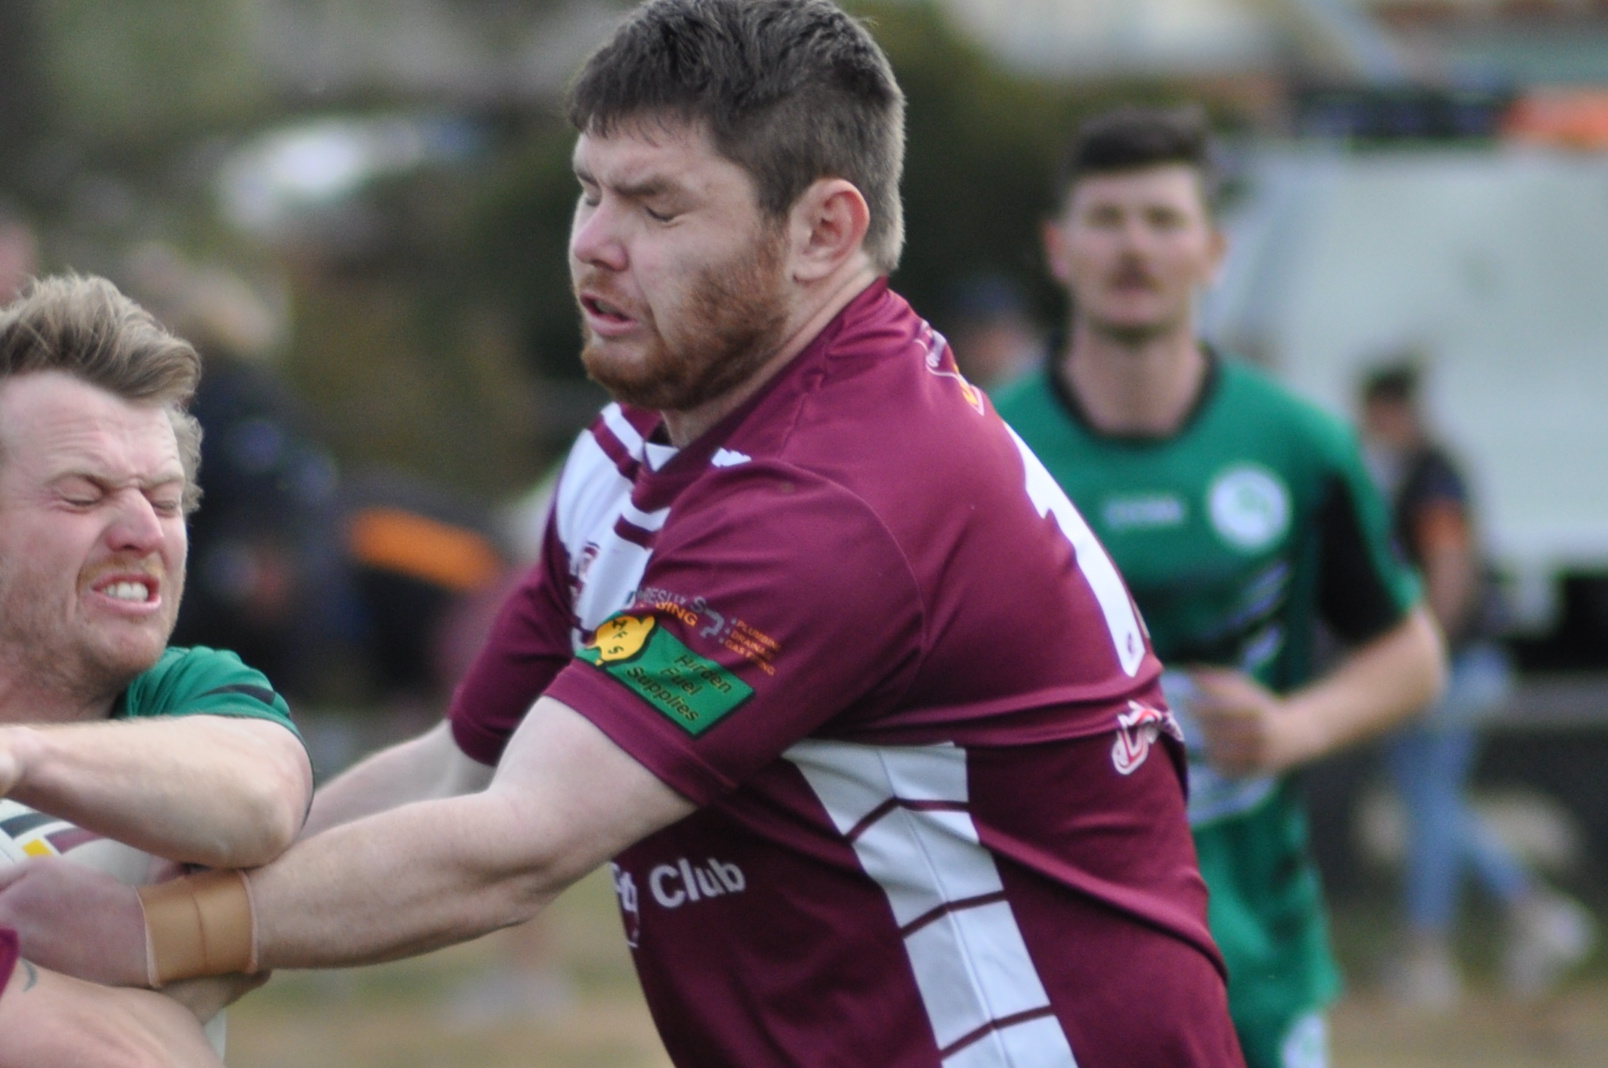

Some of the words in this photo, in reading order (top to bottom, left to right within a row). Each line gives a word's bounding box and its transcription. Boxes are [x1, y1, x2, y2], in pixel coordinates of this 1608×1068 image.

[625, 666, 699, 722] Supplies
[660, 668, 704, 696] Fuel
[649, 857, 746, 909] Club
